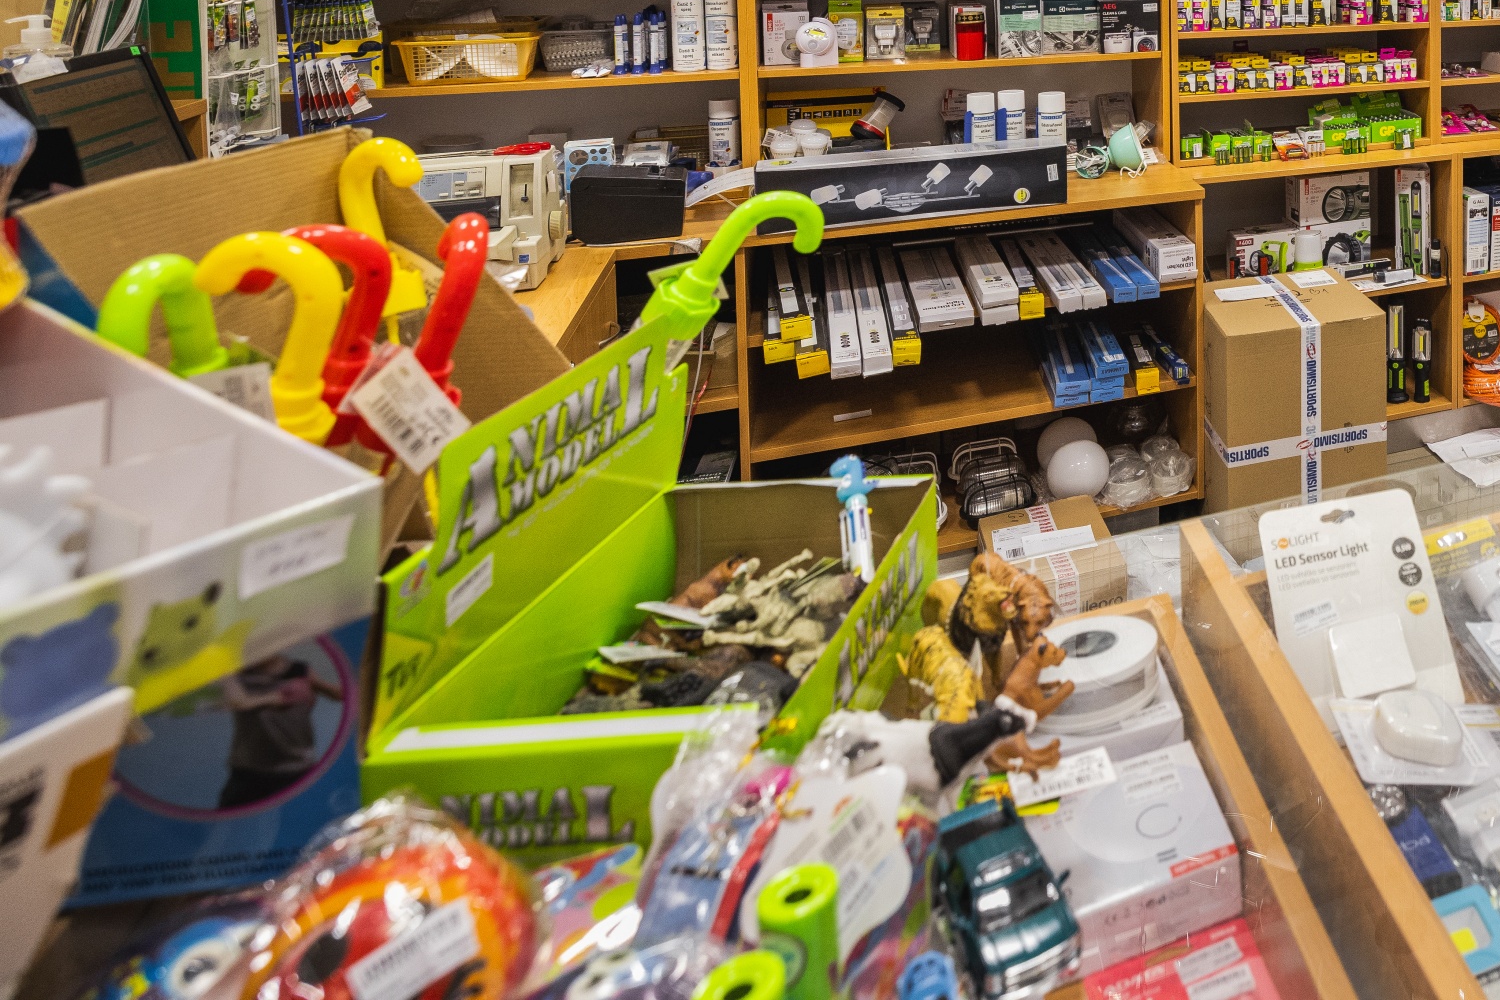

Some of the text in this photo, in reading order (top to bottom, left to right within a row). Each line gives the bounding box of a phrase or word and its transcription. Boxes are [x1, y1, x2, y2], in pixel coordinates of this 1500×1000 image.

[1331, 132, 1346, 142] GP
[1379, 125, 1395, 136] GP
[1166, 262, 1185, 270] Kitchen
[1306, 359, 1318, 419] SPORTISIMO
[1313, 428, 1369, 448] SPORTISIMO
[437, 345, 660, 577] ANIMAL
[1226, 445, 1270, 464] SPORTISI
[504, 409, 622, 525] MODEL
[1274, 541, 1369, 570] LED Sensor Light
[440, 785, 636, 843] NIMAL
